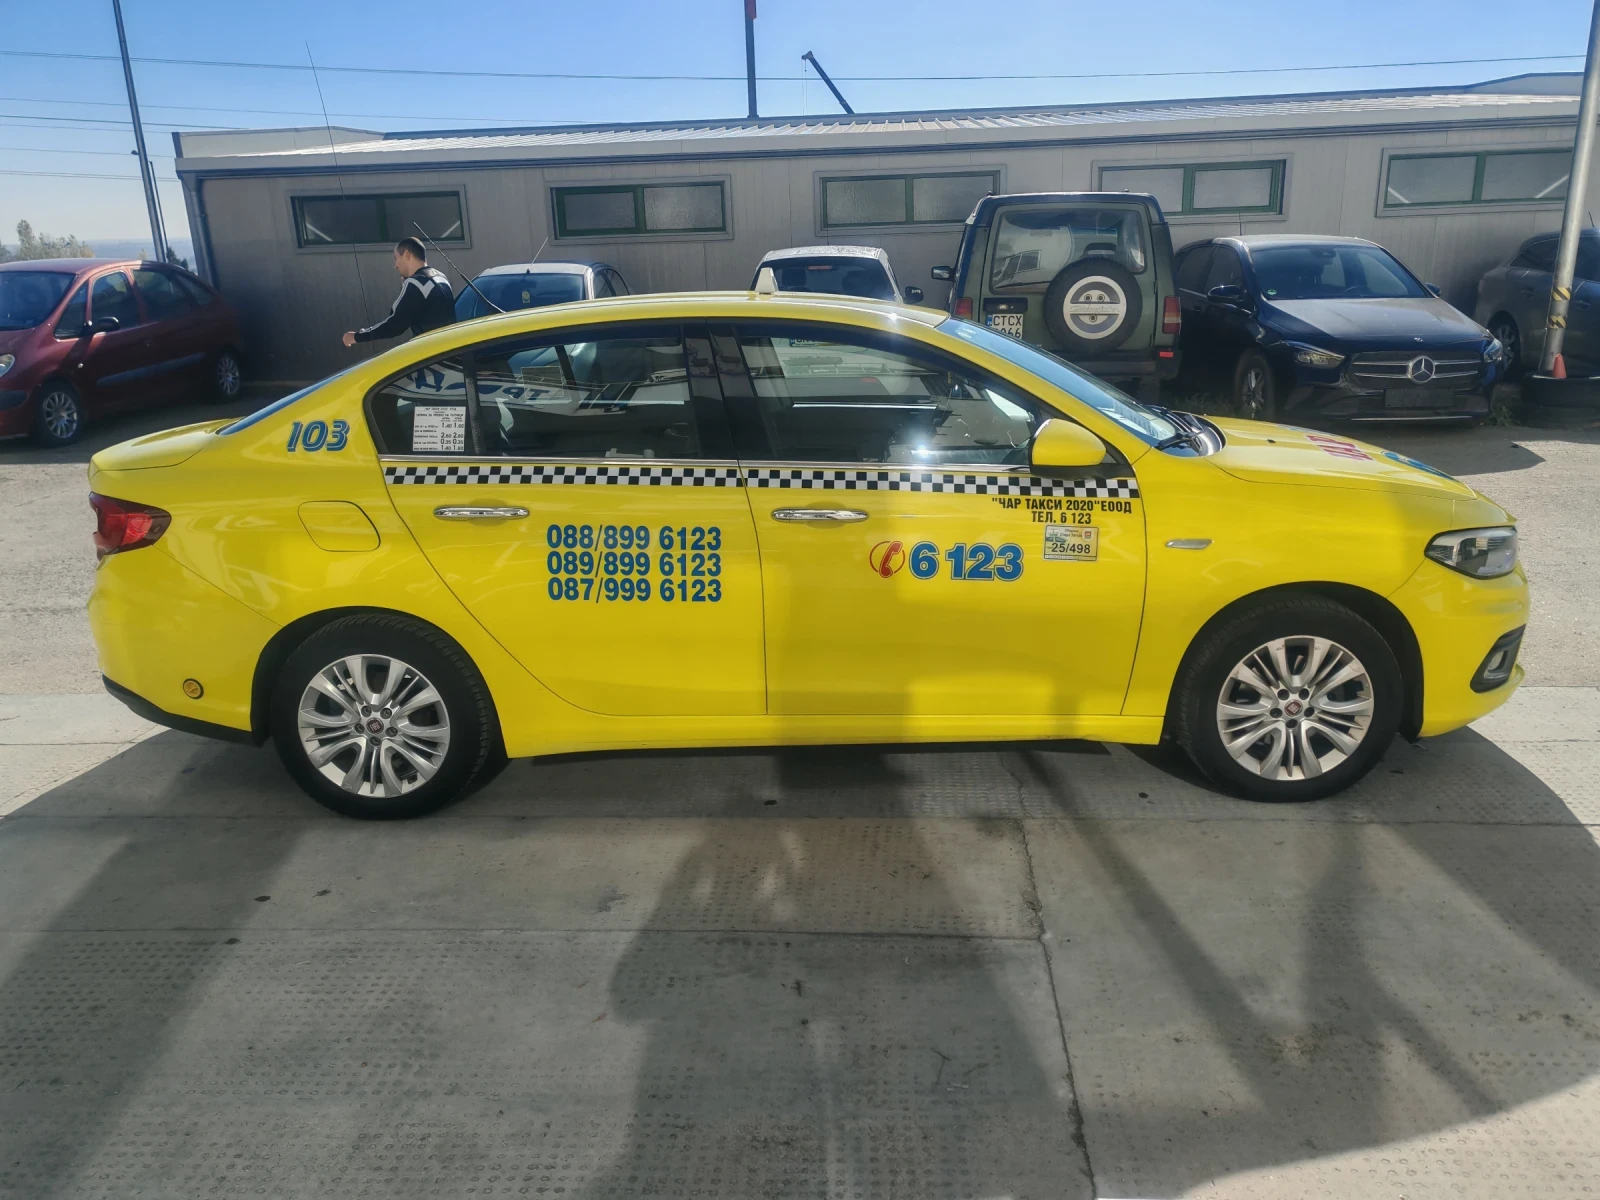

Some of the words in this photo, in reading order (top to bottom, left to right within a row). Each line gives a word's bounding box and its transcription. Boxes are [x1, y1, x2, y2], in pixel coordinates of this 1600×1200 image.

[994, 327, 1021, 338] 66
[286, 419, 350, 452] 103
[1025, 498, 1062, 510] ТАКСИ
[1031, 511, 1056, 523] ТЕЛ.
[1072, 512, 1092, 524] 123
[546, 524, 650, 551] 088/899
[659, 525, 722, 551] 6123
[1051, 543, 1091, 554] 25/498
[547, 551, 651, 578] 089/899
[659, 552, 722, 577] 6123
[547, 577, 652, 603] 087/999
[659, 578, 722, 602] 6123
